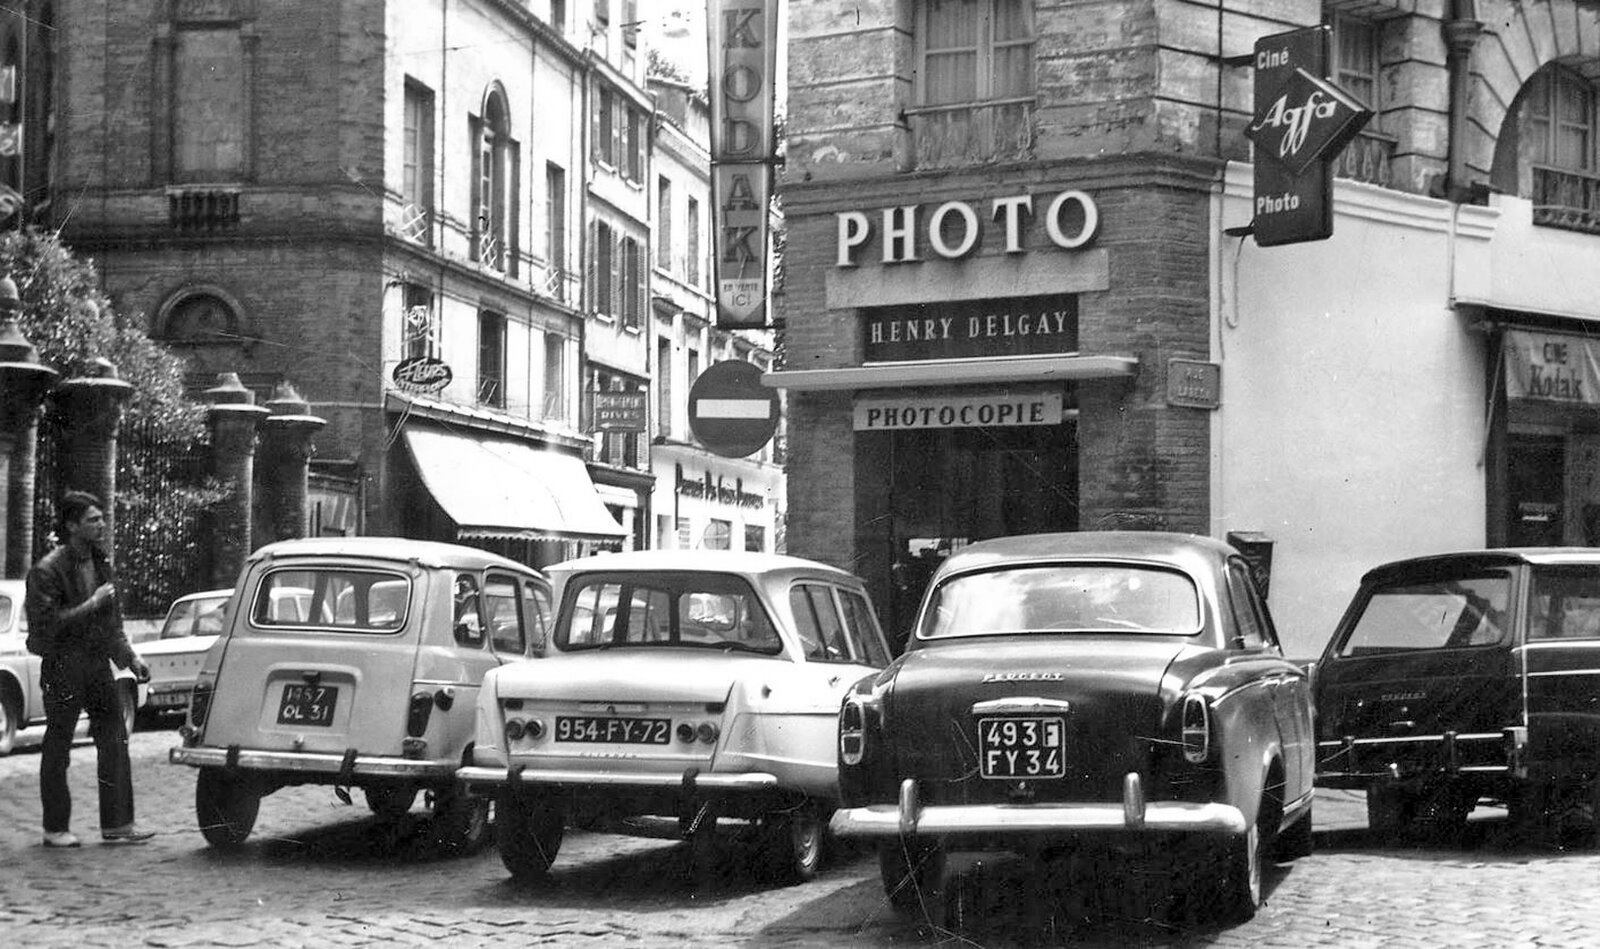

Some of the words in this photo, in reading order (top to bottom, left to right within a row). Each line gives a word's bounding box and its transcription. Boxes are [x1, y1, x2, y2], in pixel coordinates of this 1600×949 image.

[1257, 46, 1289, 70] Ciné
[722, 8, 761, 263] KODAK
[1251, 91, 1337, 158] Agfa
[1256, 192, 1299, 215] Photo
[836, 190, 1098, 267] PHOTO
[731, 293, 752, 307] ICI
[871, 317, 952, 343] HENRY
[968, 311, 1067, 338] DELGAY
[866, 402, 1043, 426] PHOTOCOPIE
[981, 672, 1064, 684] PEUGEOT
[310, 704, 329, 720] 31
[559, 719, 668, 742] 954-FY-72
[987, 721, 1037, 746] 493
